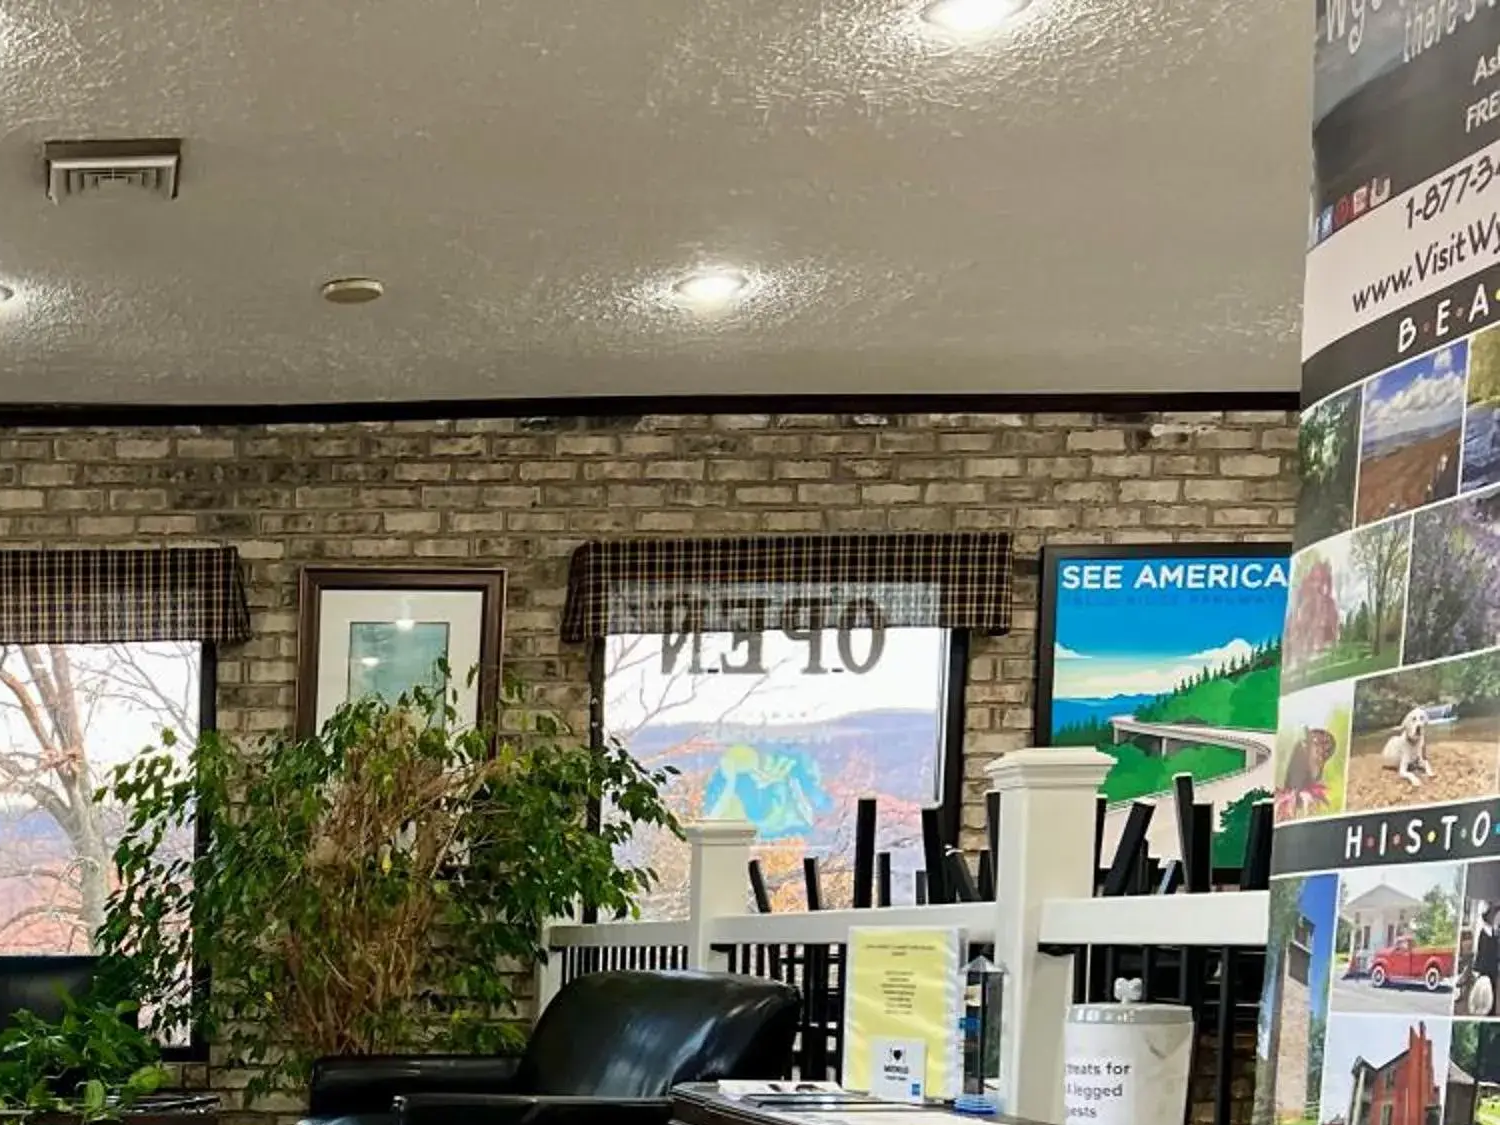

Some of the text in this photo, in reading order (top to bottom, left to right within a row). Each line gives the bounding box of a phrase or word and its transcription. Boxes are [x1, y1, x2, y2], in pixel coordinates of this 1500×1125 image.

[1406, 155, 1500, 229] 1-877-3
[1062, 563, 1288, 589] SEE AMERICA
[1106, 1061, 1132, 1075] for
